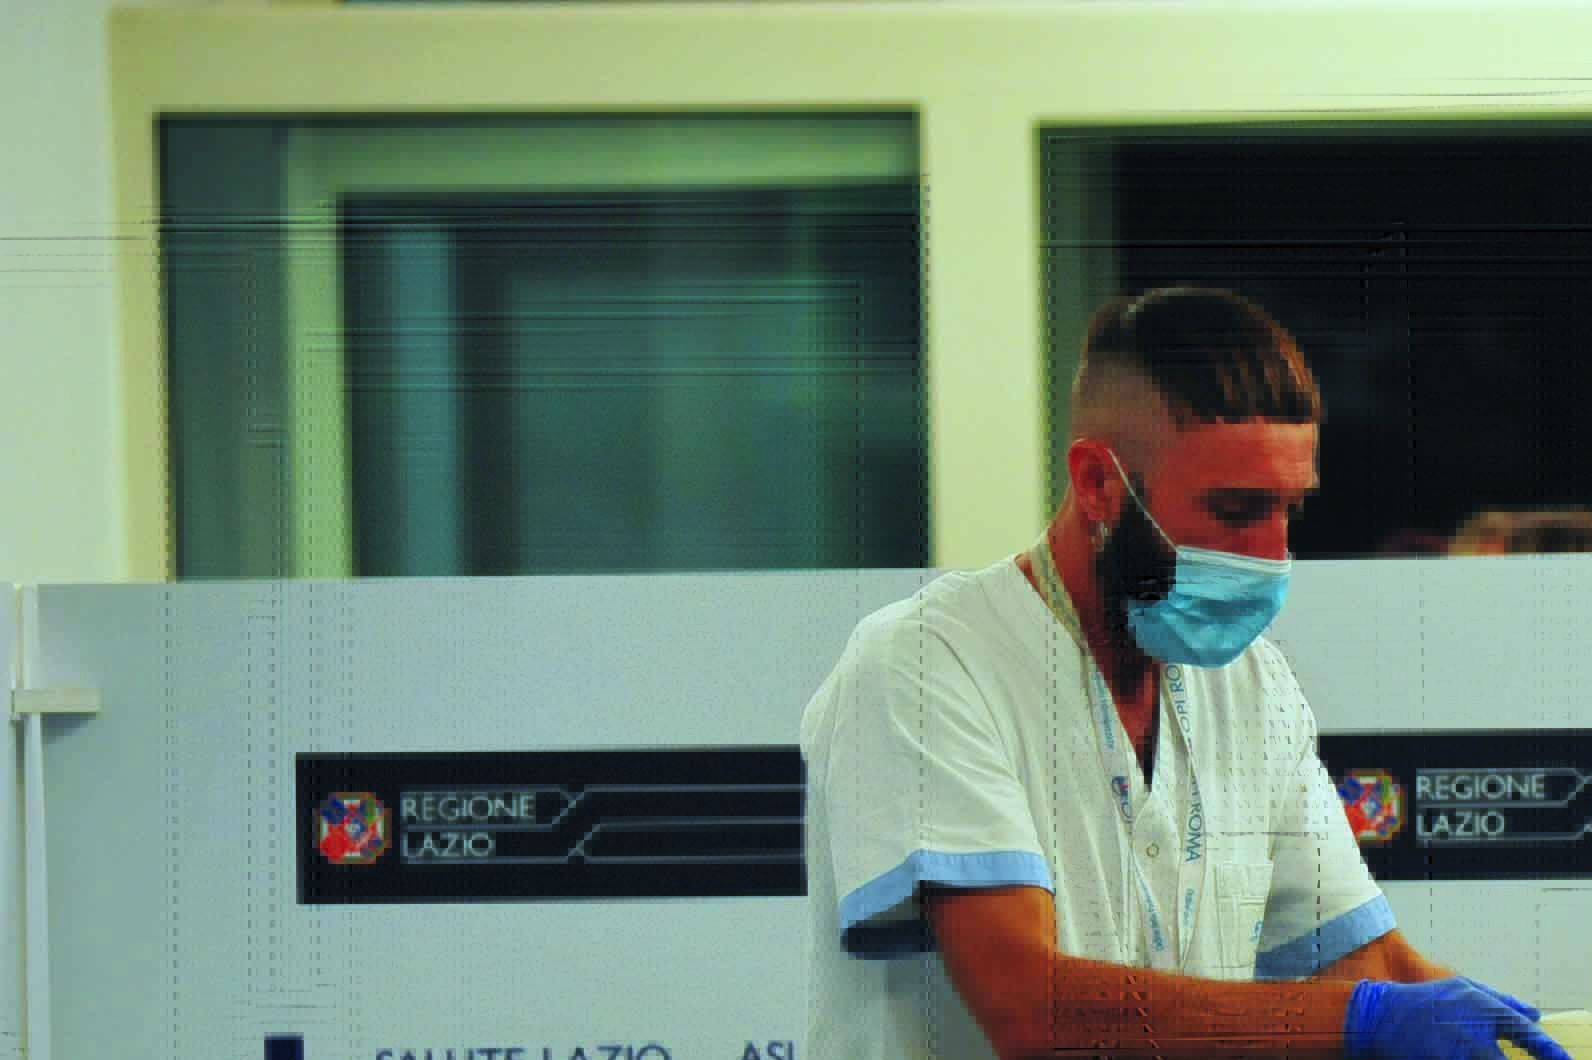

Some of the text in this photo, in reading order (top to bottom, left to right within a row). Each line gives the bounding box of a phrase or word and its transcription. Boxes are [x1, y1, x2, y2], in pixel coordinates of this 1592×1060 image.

[1417, 775, 1545, 800] REGIONE
[402, 795, 536, 821] REGIONE
[1417, 811, 1505, 837] LAZIO
[402, 832, 496, 858] LAZIO
